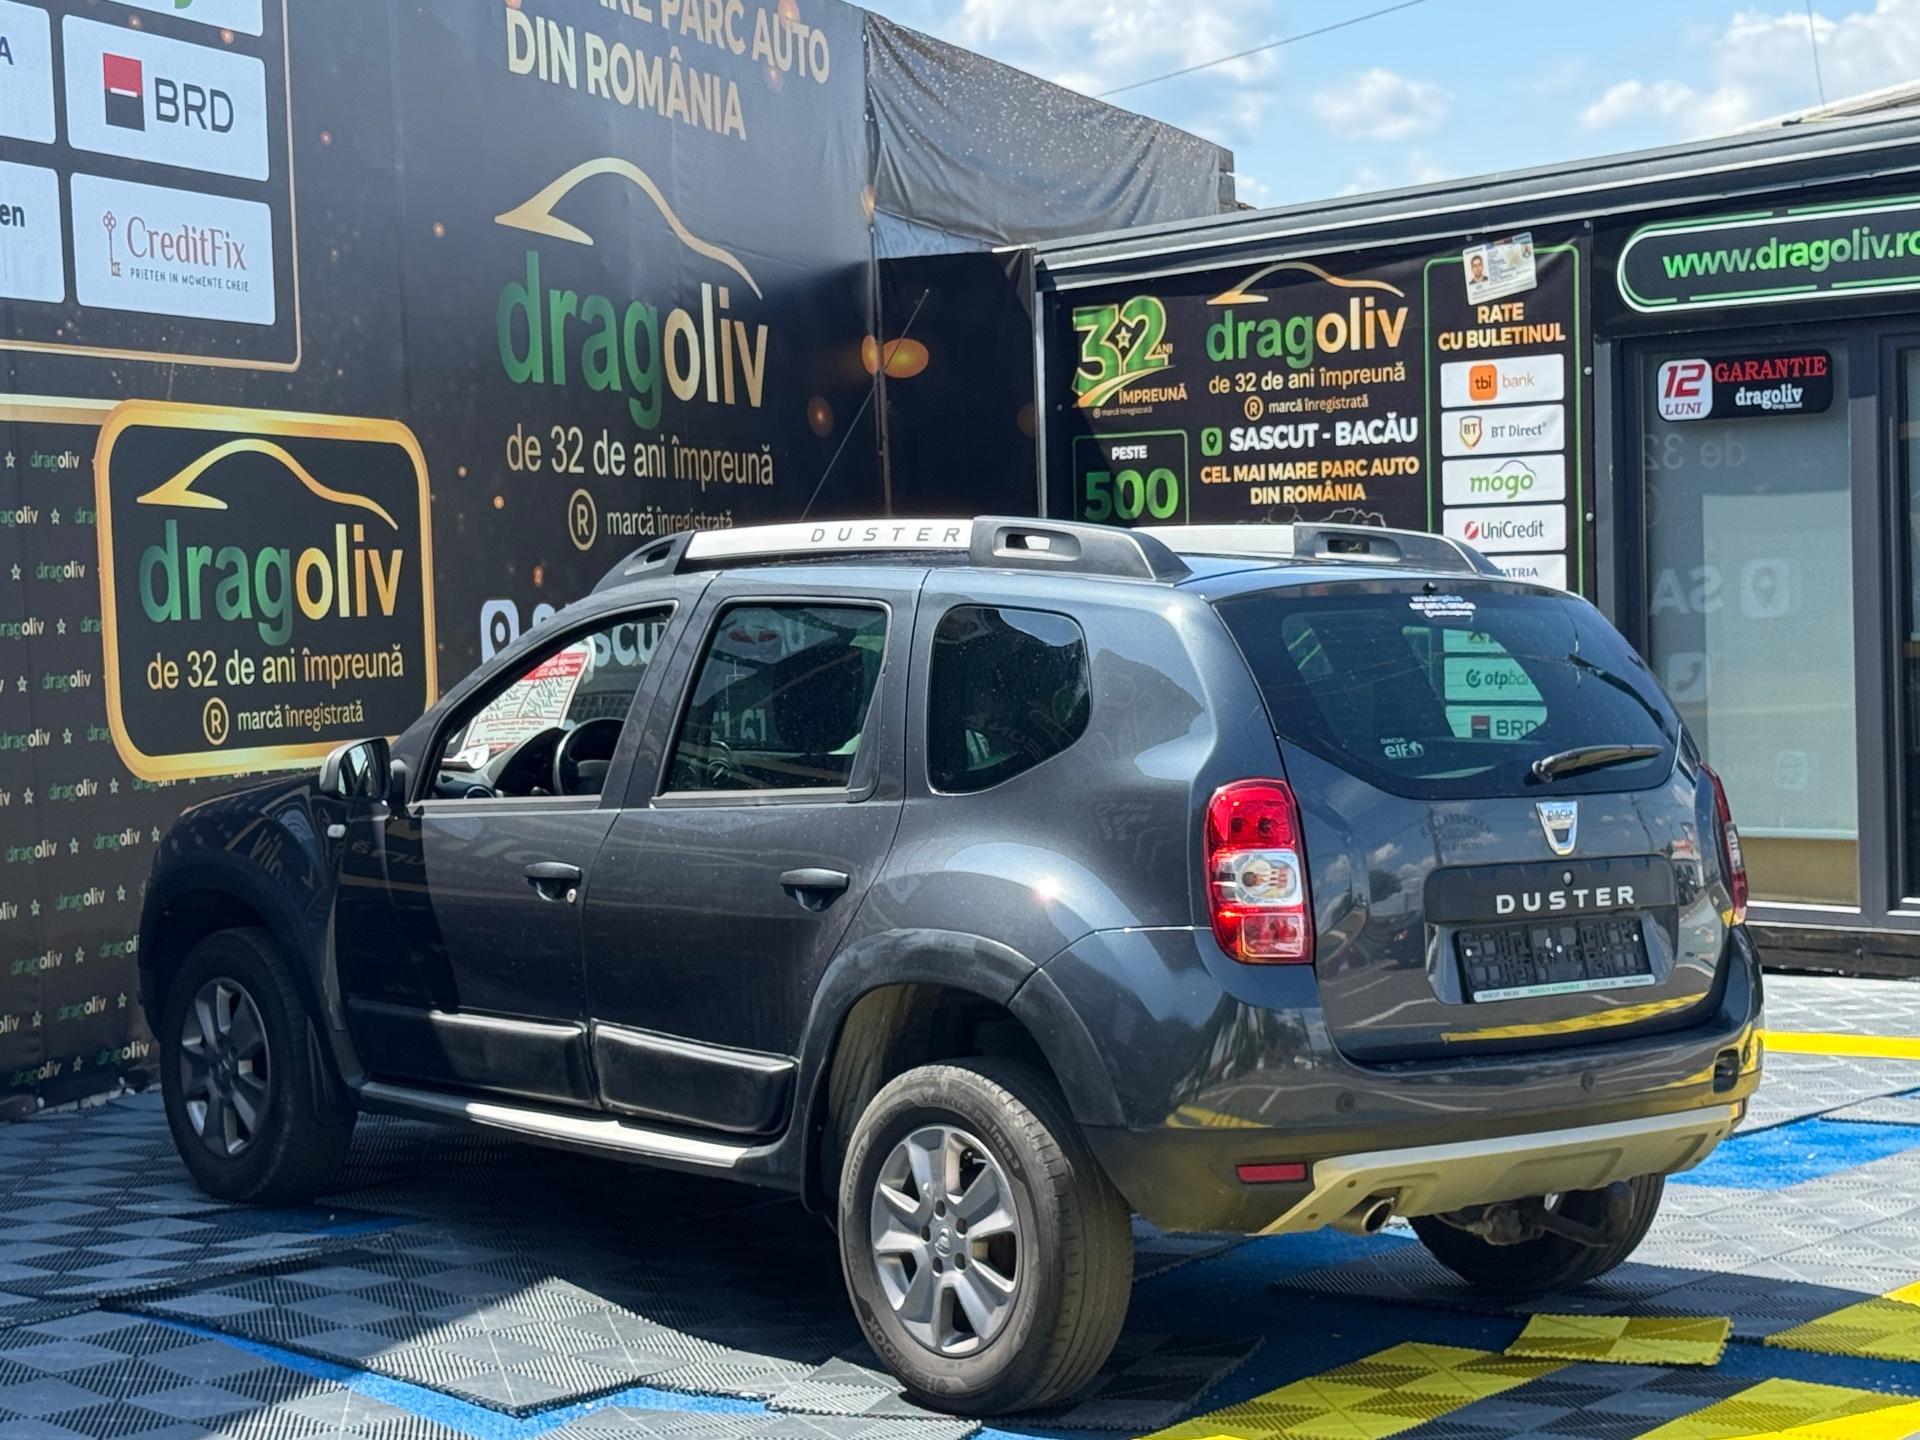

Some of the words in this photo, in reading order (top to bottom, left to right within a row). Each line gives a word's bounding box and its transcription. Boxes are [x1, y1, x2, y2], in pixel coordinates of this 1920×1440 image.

[751, 6, 831, 84] AUTO
[506, 7, 577, 90] DIN
[585, 31, 747, 141] ROMÂNIA
[154, 77, 234, 134] BRD
[127, 216, 247, 271] CreditFix
[1662, 226, 1920, 279] www.dragoliv.ro
[130, 267, 166, 281] PRIETEN
[169, 272, 179, 283] IN
[182, 274, 222, 289] MOMENTE
[226, 280, 249, 292] CHEIE
[1477, 302, 1524, 324] RATE
[496, 250, 769, 430] dragoliv
[1206, 296, 1408, 368] dragoliv
[1438, 331, 1463, 351] CU
[1466, 323, 1566, 349] BULETINUL
[1156, 343, 1173, 354] ANI
[1209, 376, 1230, 394] de
[1235, 372, 1256, 391] 32
[1261, 370, 1283, 390] de
[1288, 367, 1314, 388] ani
[1319, 361, 1406, 390] împreună
[1664, 364, 1706, 398] 12
[1714, 355, 1827, 382] GARANTIE
[1119, 383, 1188, 404] ÎMPREUNĂ
[1475, 375, 1492, 390] tbi
[1502, 373, 1535, 387] bank
[1269, 397, 1302, 413] marcă
[1305, 394, 1369, 414] înregistrată
[1735, 383, 1803, 409] dragoliv
[1665, 402, 1702, 416] LUNI
[1230, 423, 1319, 451] SASCUT
[1335, 412, 1418, 446] BACĂU
[1464, 423, 1477, 435] BT
[1491, 425, 1505, 438] BT
[30, 451, 80, 472] dragoliv
[506, 423, 542, 473] de
[550, 425, 585, 474] 32
[593, 429, 626, 476] de
[633, 435, 667, 479] ani
[673, 436, 774, 492] împreună
[1112, 445, 1147, 461] PESTE
[1201, 466, 1231, 483] CEL
[1233, 464, 1265, 482] MAI
[1269, 462, 1318, 481] MARE
[1321, 459, 1369, 478] PARC
[1371, 456, 1419, 476] AUTO
[1084, 468, 1178, 519] 500
[1251, 487, 1280, 506] DIN
[1284, 480, 1366, 503] ROMÂNIA
[1470, 474, 1534, 499] mogo
[607, 505, 655, 536] marcă
[1481, 520, 1543, 540] UniCredit
[810, 527, 961, 543] DUSTER
[36, 561, 85, 582] dragoliv
[139, 519, 403, 647] dragoliv
[1502, 568, 1538, 578] ATRIA
[148, 653, 179, 690] de
[187, 650, 219, 688] 32
[225, 649, 255, 686] de
[262, 648, 297, 684] ani
[302, 644, 404, 689] împreună
[42, 670, 91, 691] dragoliv
[237, 707, 282, 731] marcă
[284, 700, 364, 731] înregistrată
[1384, 744, 1408, 757] elf
[49, 778, 98, 802] dragoliv
[1547, 809, 1574, 819] DACIA
[6, 840, 57, 864] dragoliv
[93, 828, 141, 851] dragoliv
[56, 887, 106, 912] dragoliv
[1496, 885, 1635, 915] DUSTER
[11, 949, 62, 976] dragoliv
[57, 995, 106, 1020] dragoliv
